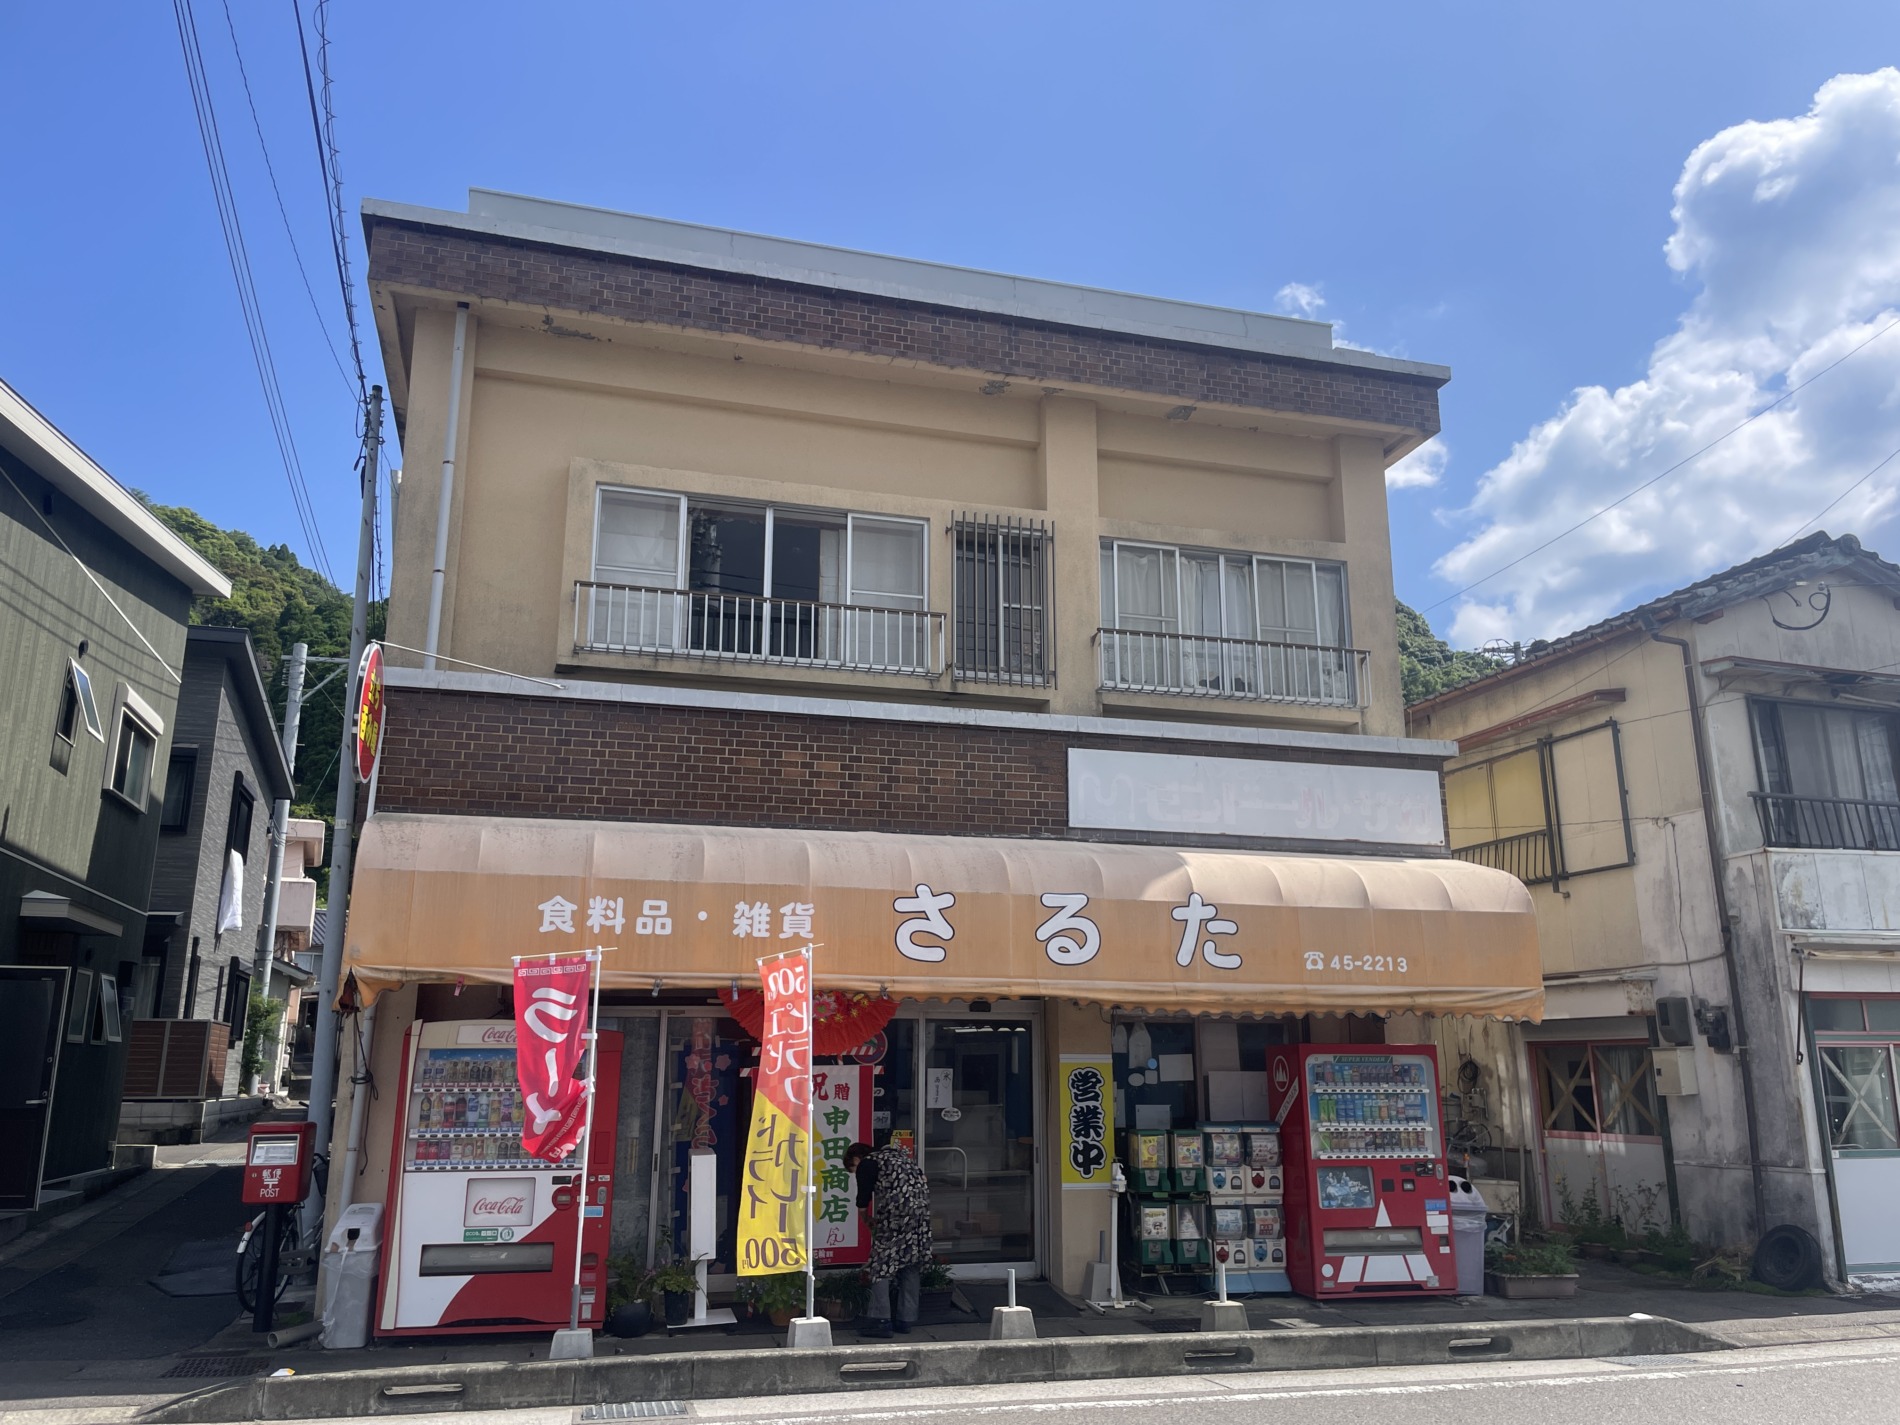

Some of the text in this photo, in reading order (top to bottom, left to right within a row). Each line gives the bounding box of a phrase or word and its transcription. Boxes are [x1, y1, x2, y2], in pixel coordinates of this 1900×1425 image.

[537, 895, 815, 939] 食料品・雑貨
[893, 883, 1242, 971] さるた
[1331, 955, 1407, 973] 45-2213
[833, 1082, 850, 1101] 贈
[1068, 1067, 1107, 1179] 営業中
[819, 1105, 851, 1223] 申田商店
[262, 1168, 282, 1180] 郵便
[259, 1188, 280, 1198] POST
[472, 1196, 527, 1215] Coca-Cola
